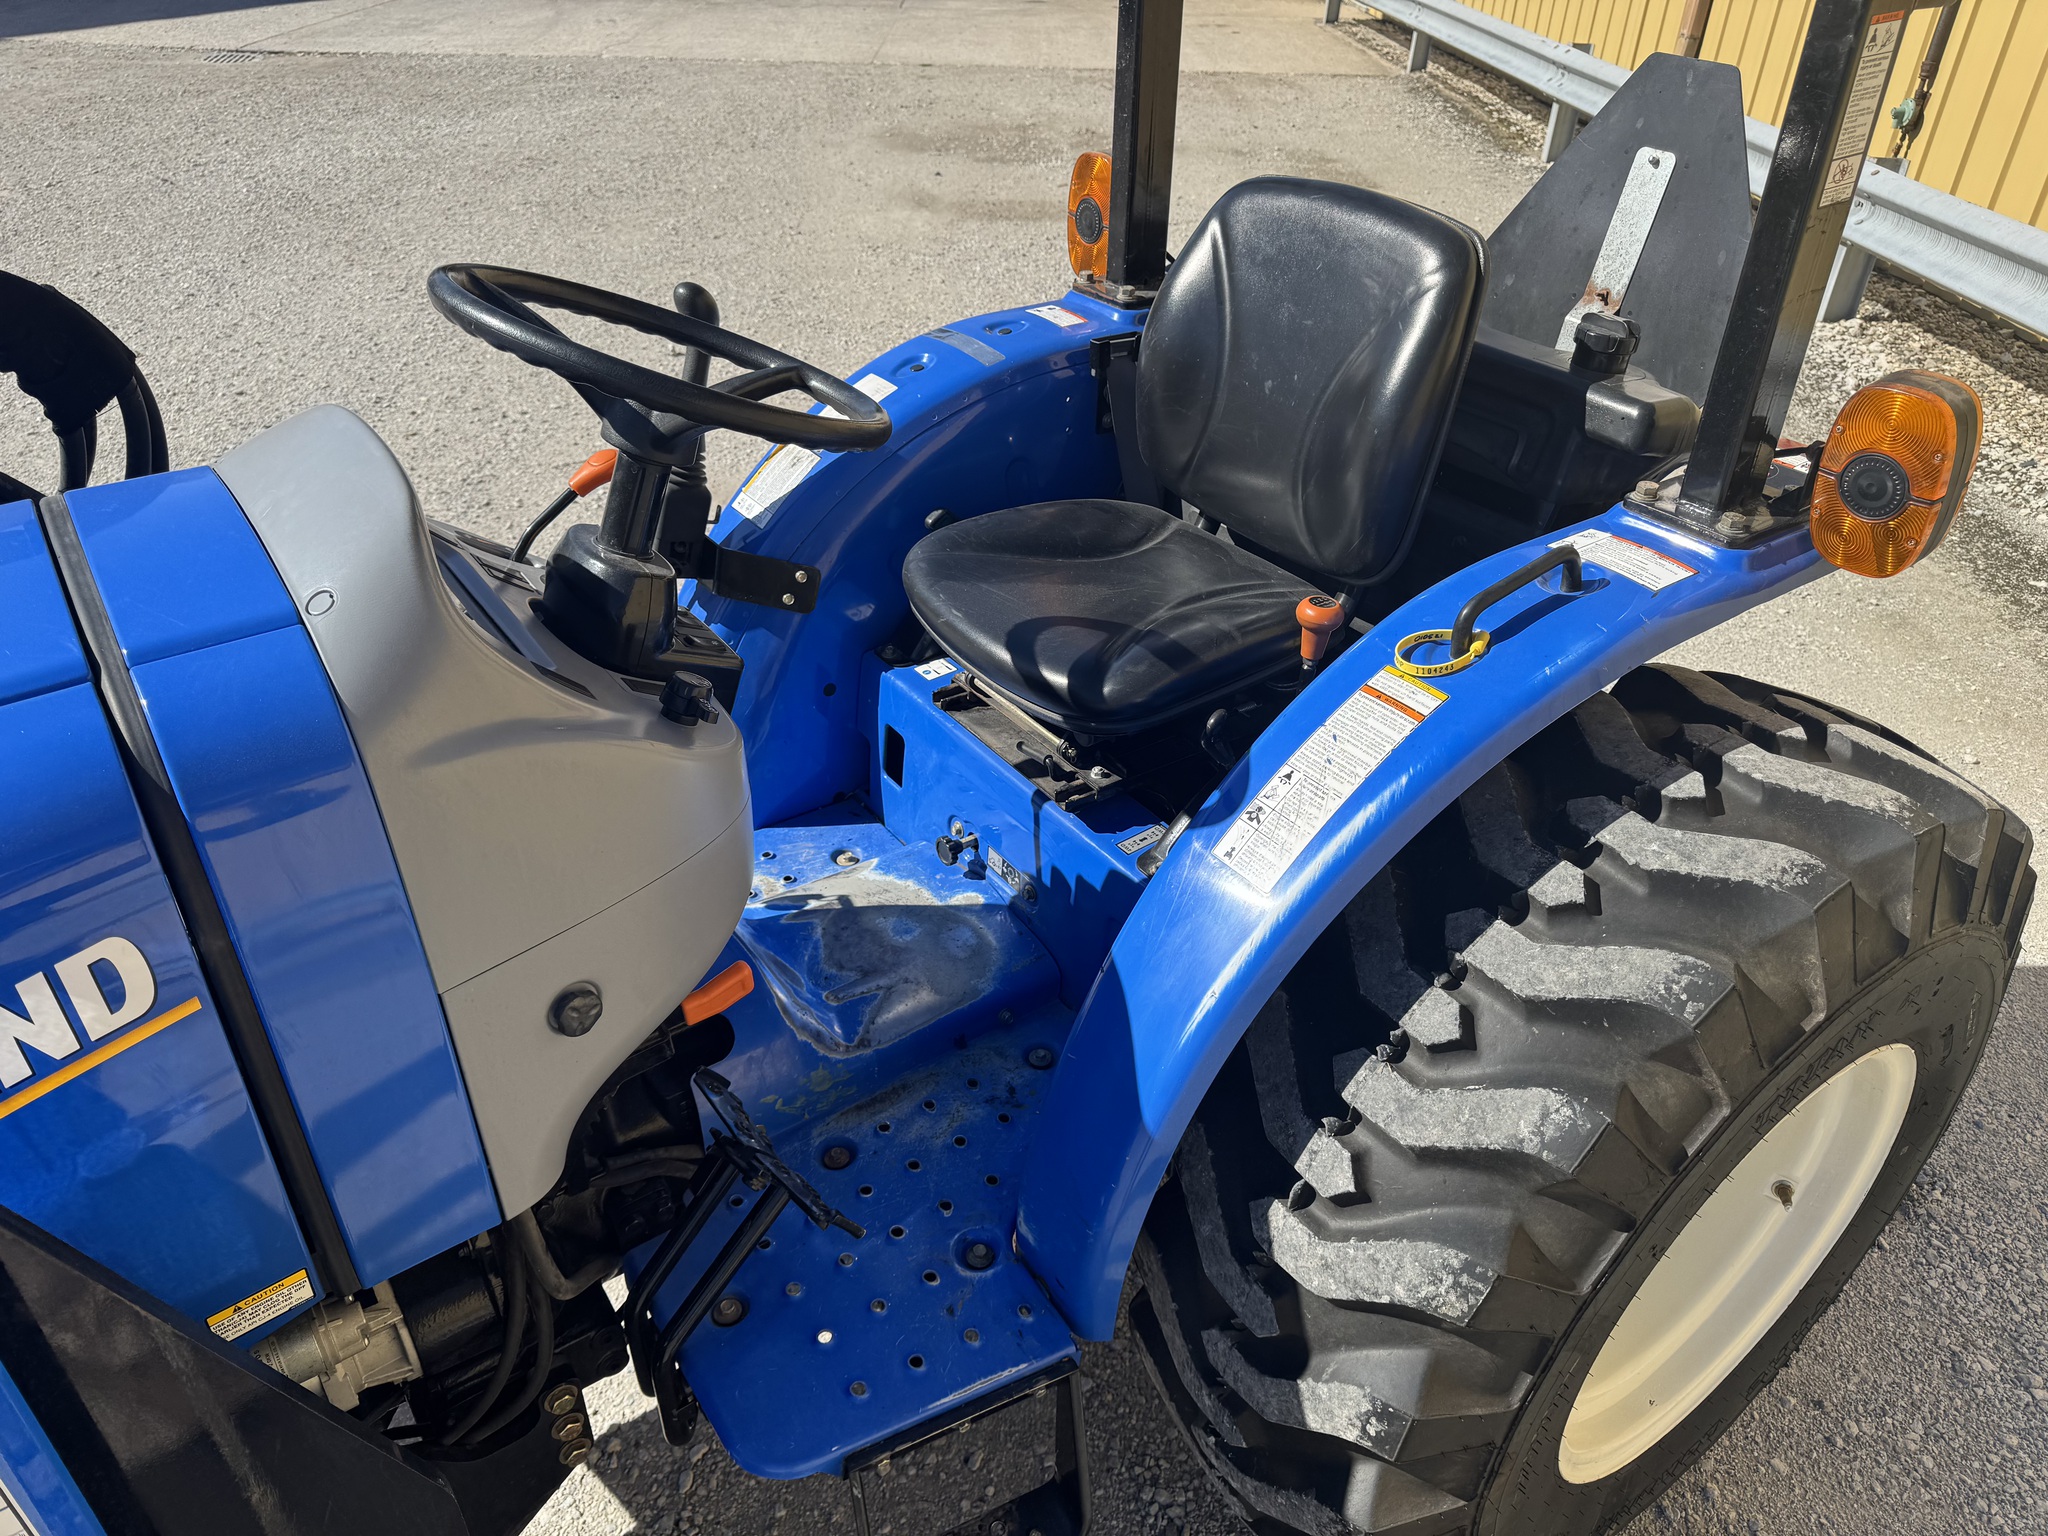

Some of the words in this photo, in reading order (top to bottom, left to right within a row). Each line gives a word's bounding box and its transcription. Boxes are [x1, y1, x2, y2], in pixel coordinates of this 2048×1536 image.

[1407, 677, 1431, 691] CAUTION
[1384, 698, 1408, 712] WARNING
[244, 1283, 284, 1306] CAUTION
[212, 1322, 225, 1330] USE
[237, 1310, 249, 1318] ANY
[250, 1297, 273, 1311] ENGINE
[286, 1280, 307, 1292] OTHER
[248, 1307, 261, 1316] MAY
[262, 1298, 280, 1309] CLOG
[281, 1291, 293, 1299] THE
[271, 1301, 293, 1314] ENGINE
[244, 1313, 260, 1323] THAN
